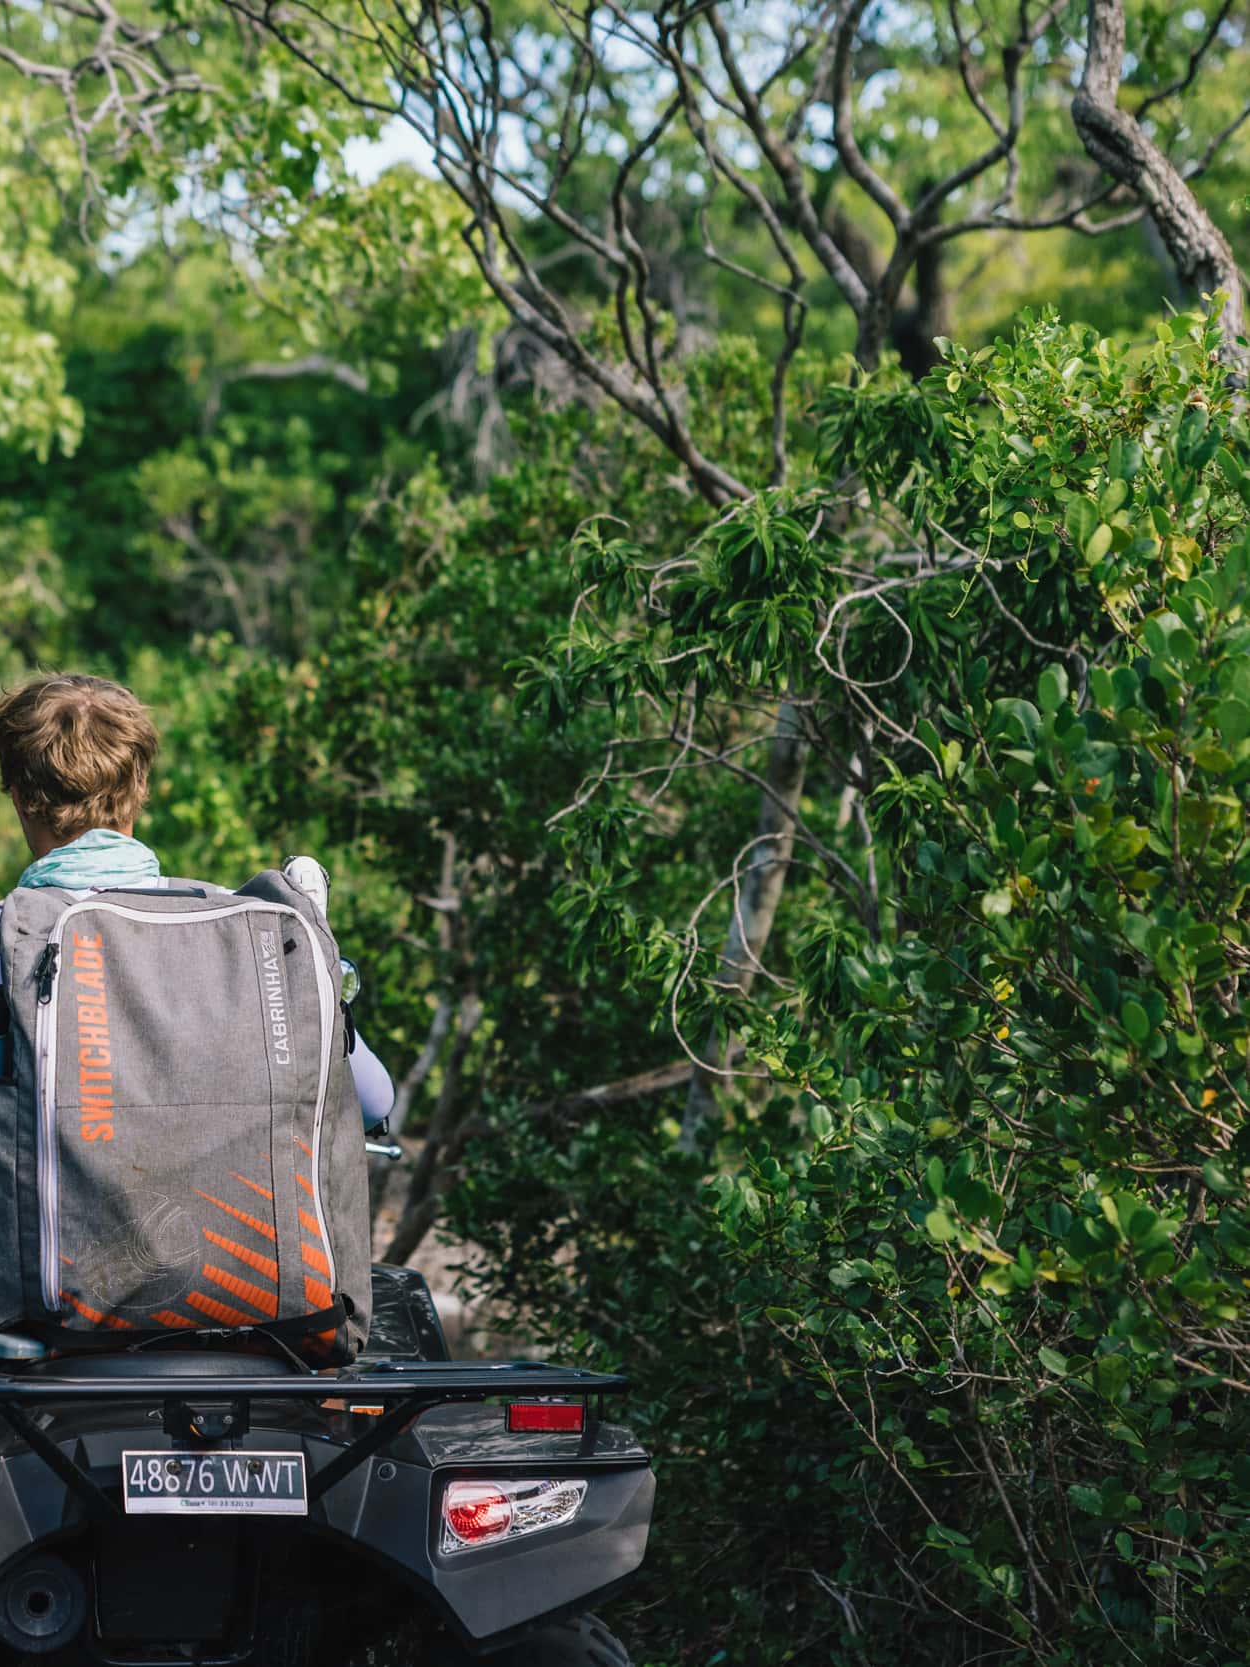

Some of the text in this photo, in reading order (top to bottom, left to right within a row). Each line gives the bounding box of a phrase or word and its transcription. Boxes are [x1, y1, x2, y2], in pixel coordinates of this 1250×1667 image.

[72, 931, 115, 1144] SWITCHBLADE
[263, 957, 290, 1065] CABRINHA
[129, 1458, 298, 1494] 48876 WWT
